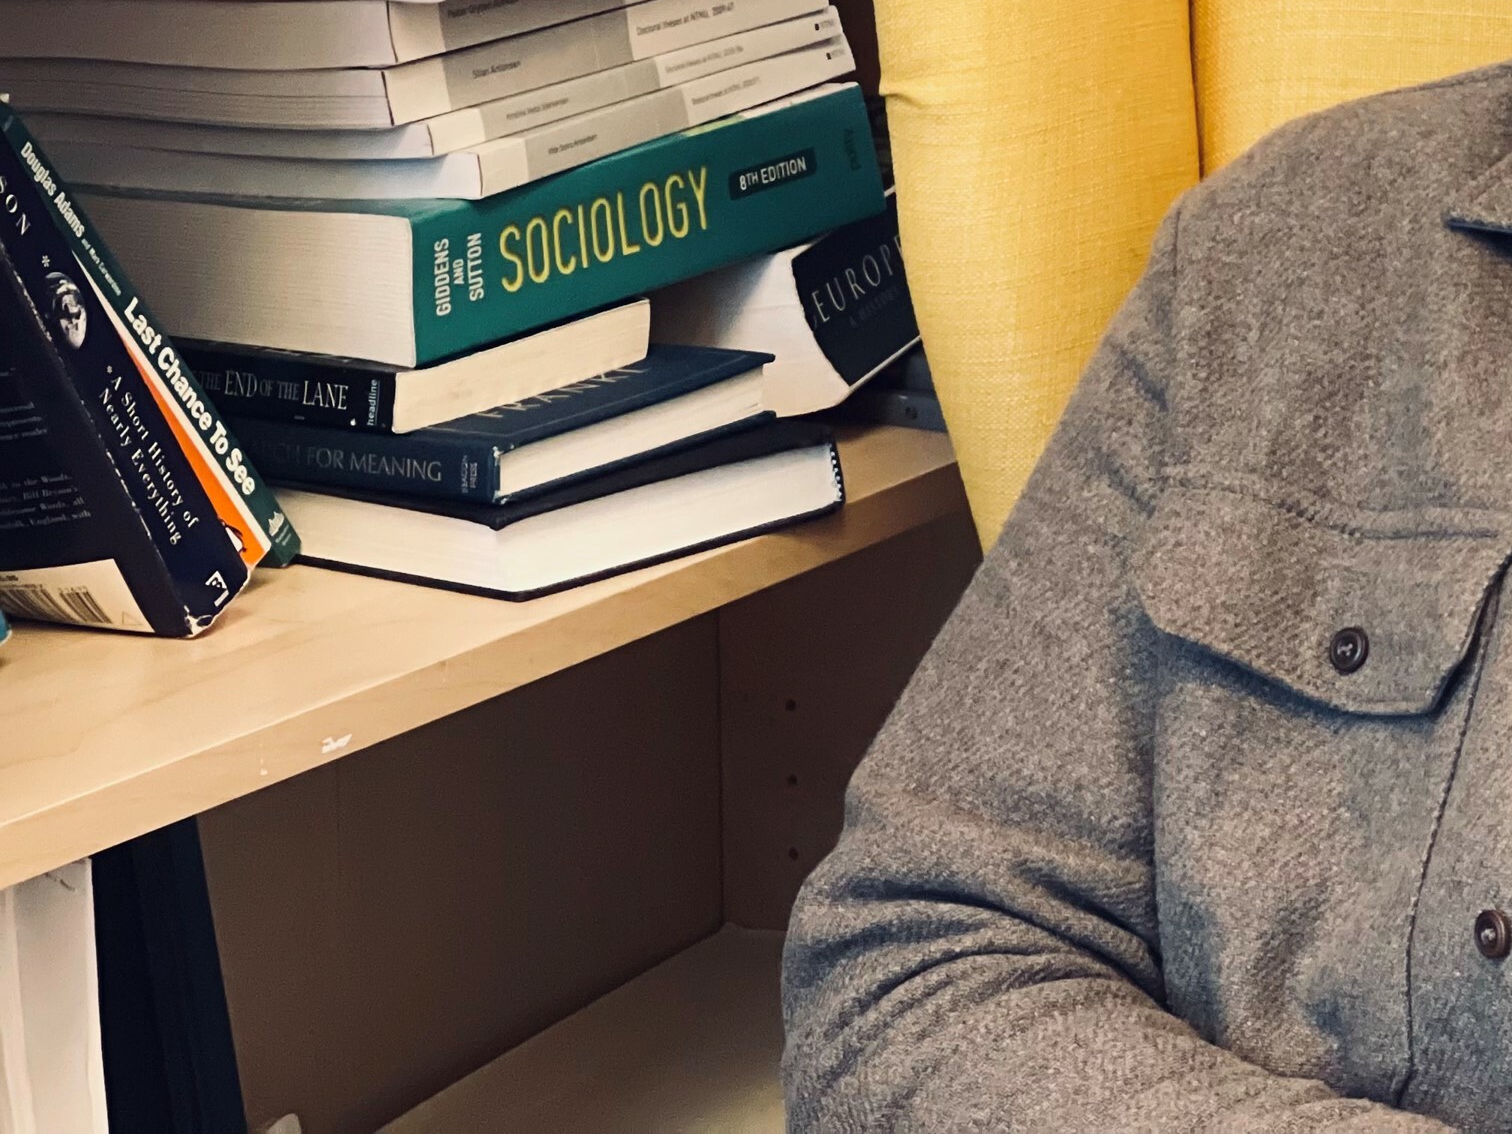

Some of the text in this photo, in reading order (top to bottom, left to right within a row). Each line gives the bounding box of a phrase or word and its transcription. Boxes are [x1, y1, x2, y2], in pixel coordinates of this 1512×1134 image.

[21, 141, 57, 196] Douglas
[54, 191, 85, 238] Adams
[739, 156, 806, 191] 8TH EDITION
[499, 166, 707, 293] SOCIOLOGY
[434, 238, 451, 316] GIDDENS
[453, 258, 465, 285] AND
[467, 233, 484, 301] SUTTON
[124, 296, 256, 496] Last Chance To See
[224, 370, 258, 397] END
[259, 378, 273, 396] OF
[277, 380, 300, 401] THE
[302, 380, 349, 410] LANE
[366, 379, 377, 426] headline
[99, 387, 182, 546] Nearly Everything
[111, 376, 199, 528] A Short History of
[307, 448, 344, 468] FOR
[350, 452, 443, 482] MEANING
